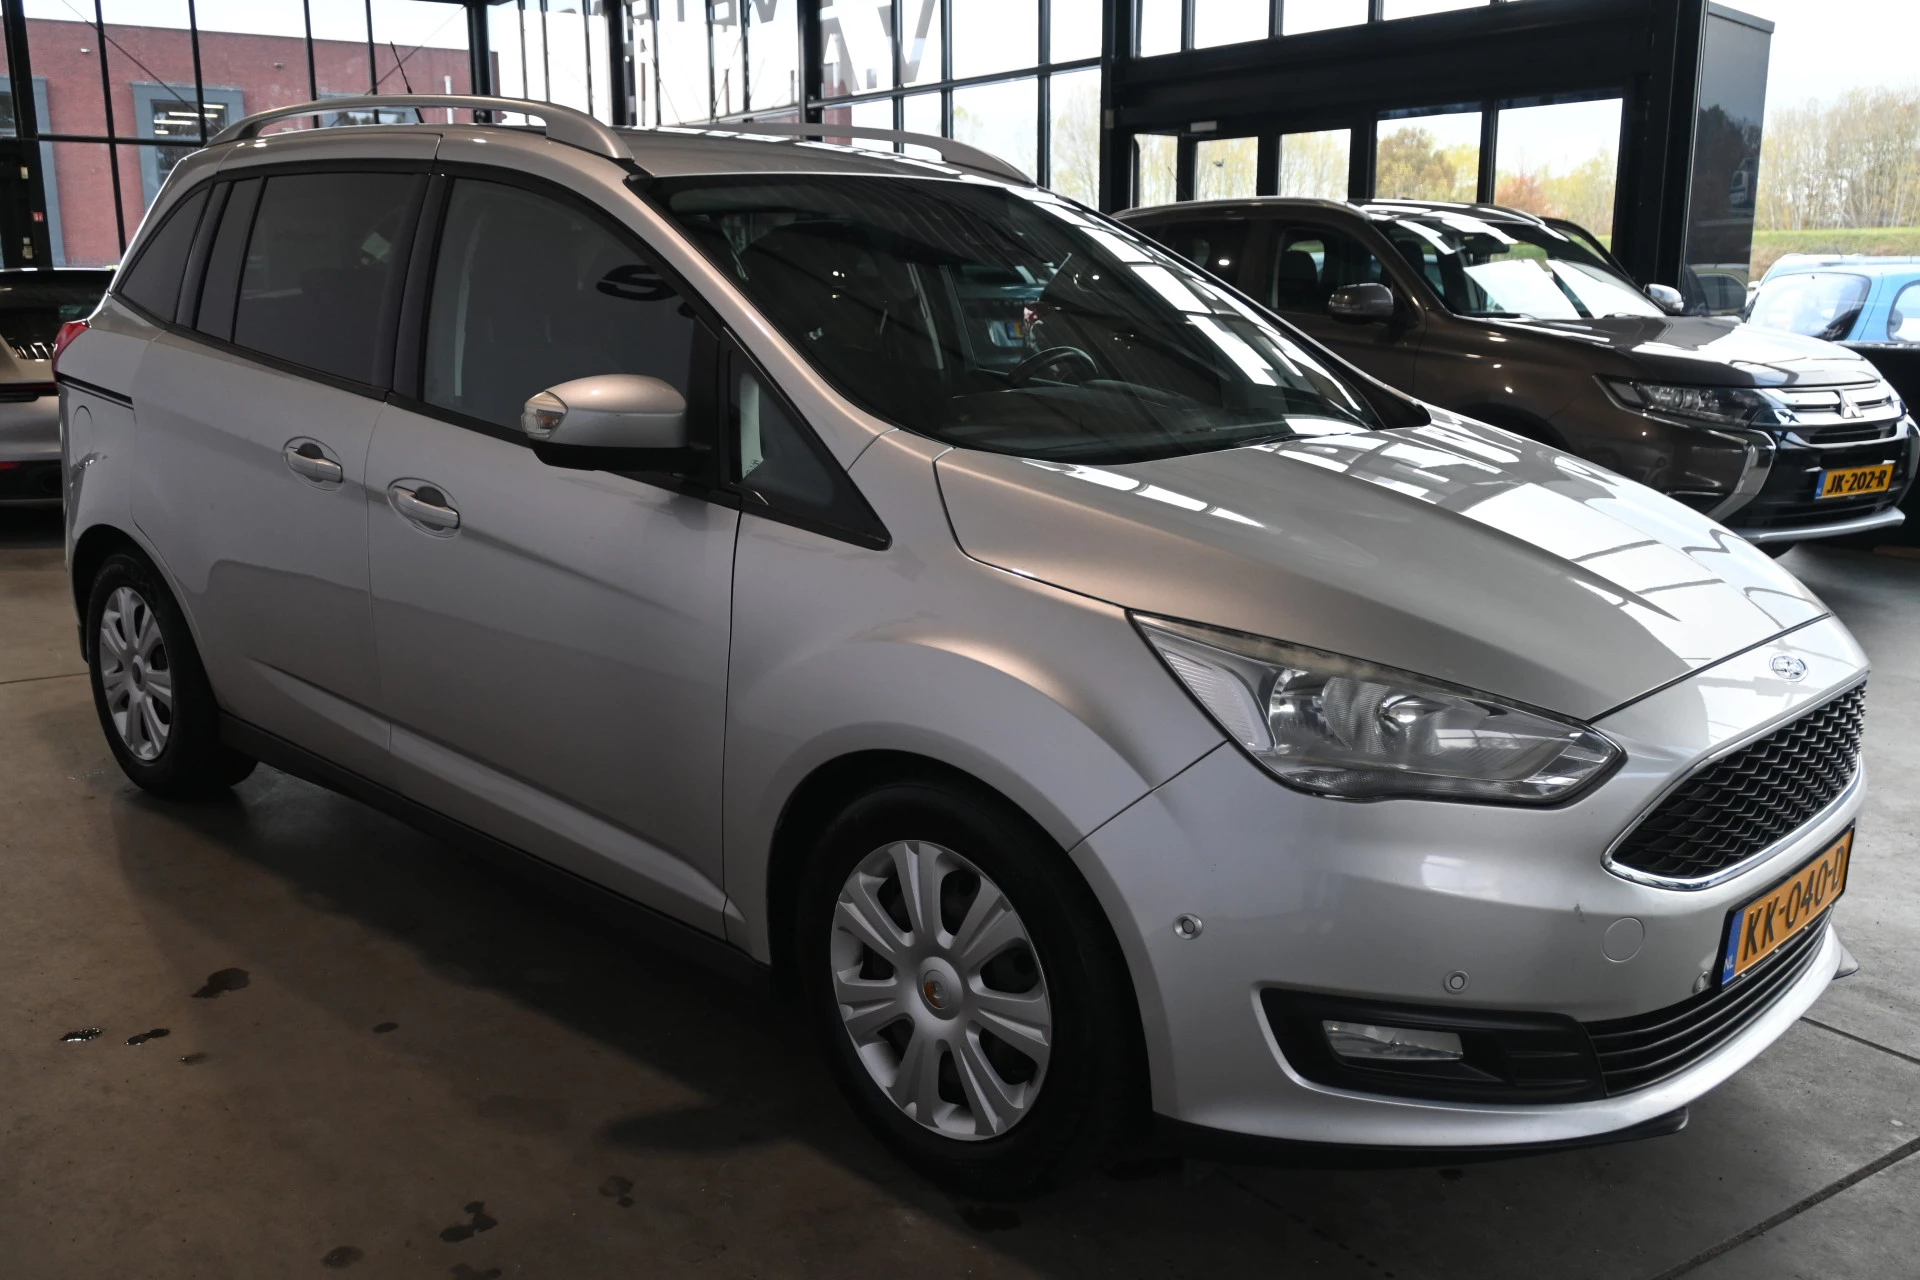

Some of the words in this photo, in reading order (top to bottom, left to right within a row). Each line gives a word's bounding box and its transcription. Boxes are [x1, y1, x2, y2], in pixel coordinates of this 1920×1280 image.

[1827, 470, 1887, 493] JK-202-R
[1743, 845, 1845, 962] KK-040-D
[1723, 955, 1734, 973] NL
